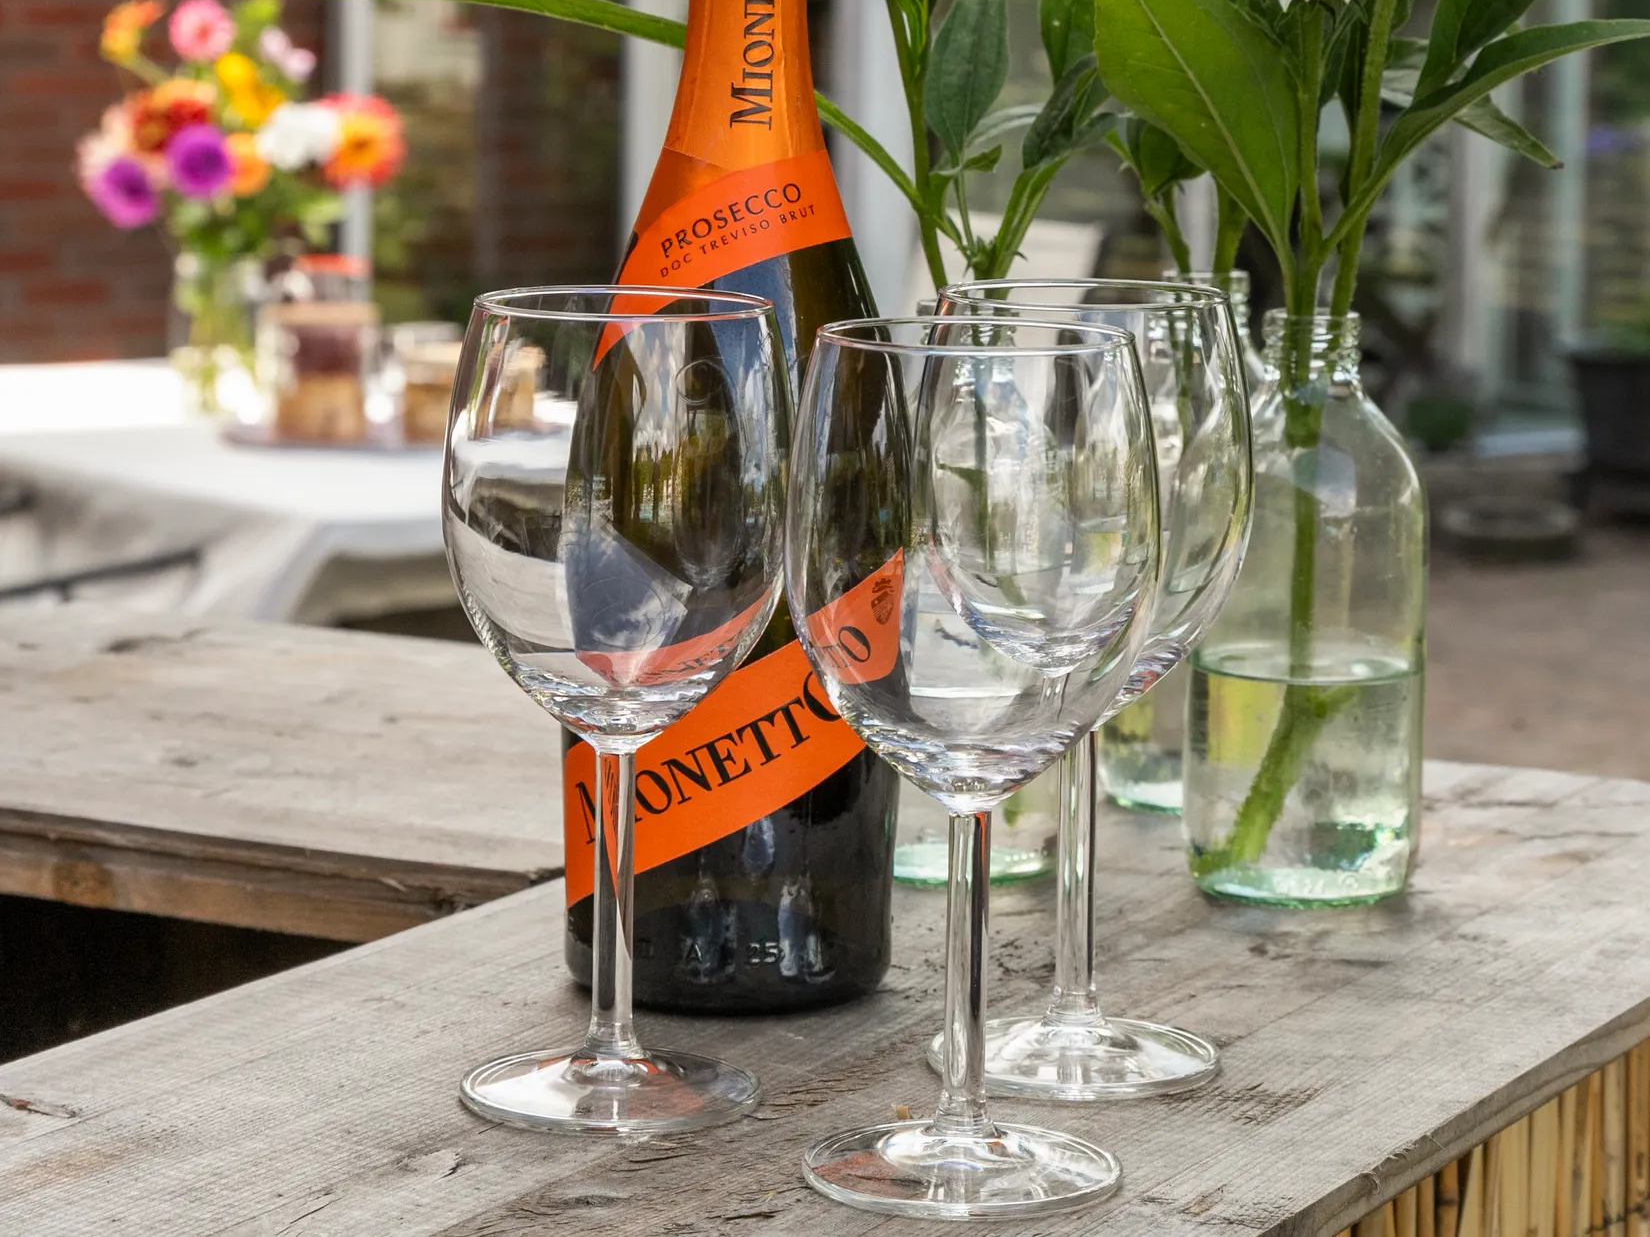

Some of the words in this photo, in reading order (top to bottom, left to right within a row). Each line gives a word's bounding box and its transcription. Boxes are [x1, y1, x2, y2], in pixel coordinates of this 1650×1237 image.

[660, 183, 802, 258] PROSECCO
[660, 252, 693, 279] DOC
[699, 219, 771, 255] TREVISO
[779, 204, 816, 225] BRUT
